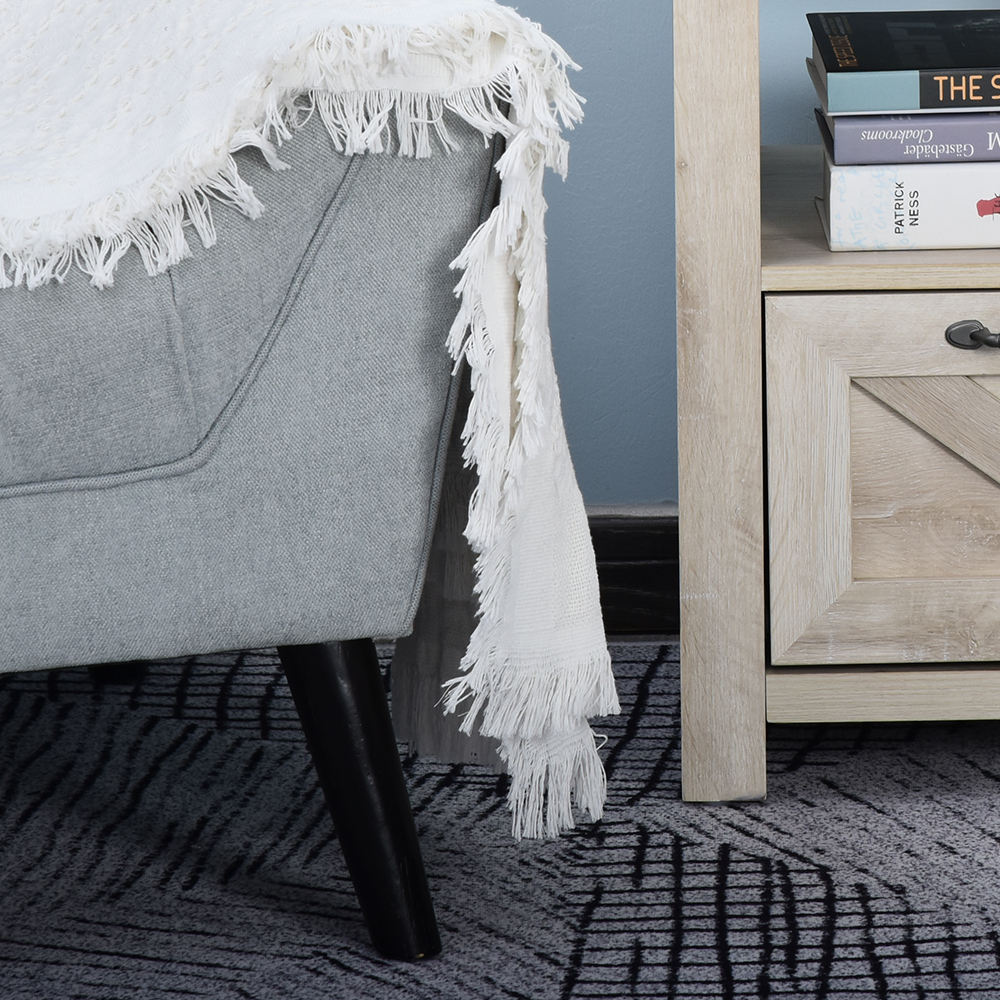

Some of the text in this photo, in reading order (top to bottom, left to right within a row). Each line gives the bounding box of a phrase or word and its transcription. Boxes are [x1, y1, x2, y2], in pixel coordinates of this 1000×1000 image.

[933, 75, 983, 101] THE
[861, 128, 934, 144] Cloakrooms
[903, 143, 975, 159] Gästebäder
[894, 181, 904, 234] PATRICK
[909, 190, 919, 227] NESS
